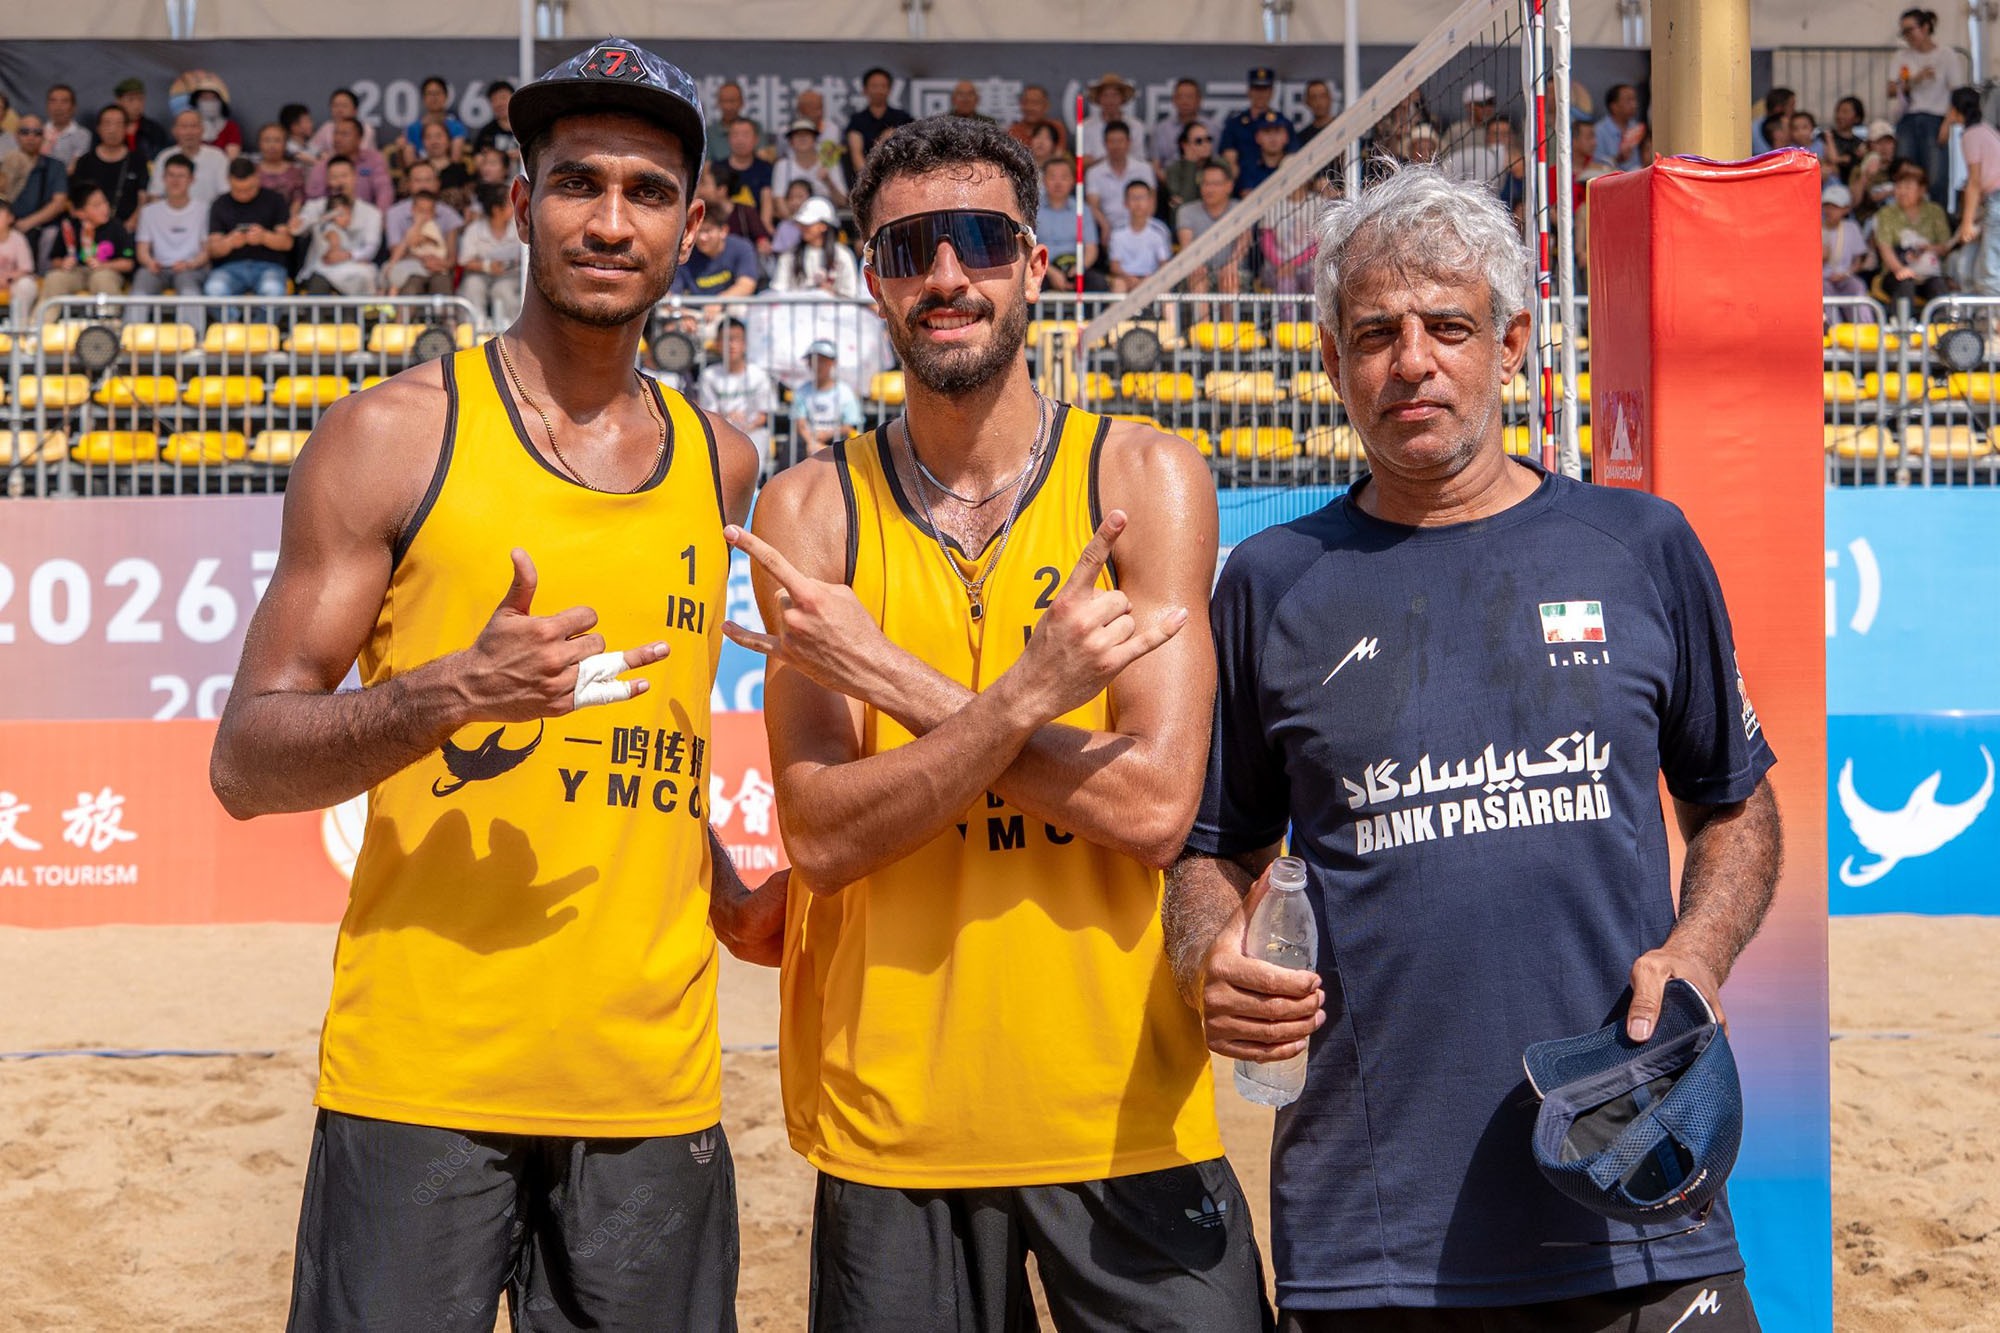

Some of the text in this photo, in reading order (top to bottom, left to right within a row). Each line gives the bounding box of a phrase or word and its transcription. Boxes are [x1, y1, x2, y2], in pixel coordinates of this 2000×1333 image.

[605, 51, 627, 75] 7
[353, 79, 494, 129] 206
[680, 544, 696, 586] 1
[1033, 566, 1061, 610] 2
[666, 594, 705, 634] IRI
[1549, 650, 1610, 667] I.R.I
[1516, 730, 1611, 783] بانک
[1355, 783, 1612, 856] BANK PASARGAD
[33, 864, 139, 887] TOURISM
[412, 1135, 480, 1206] adida
[576, 1184, 653, 1258] adidas
